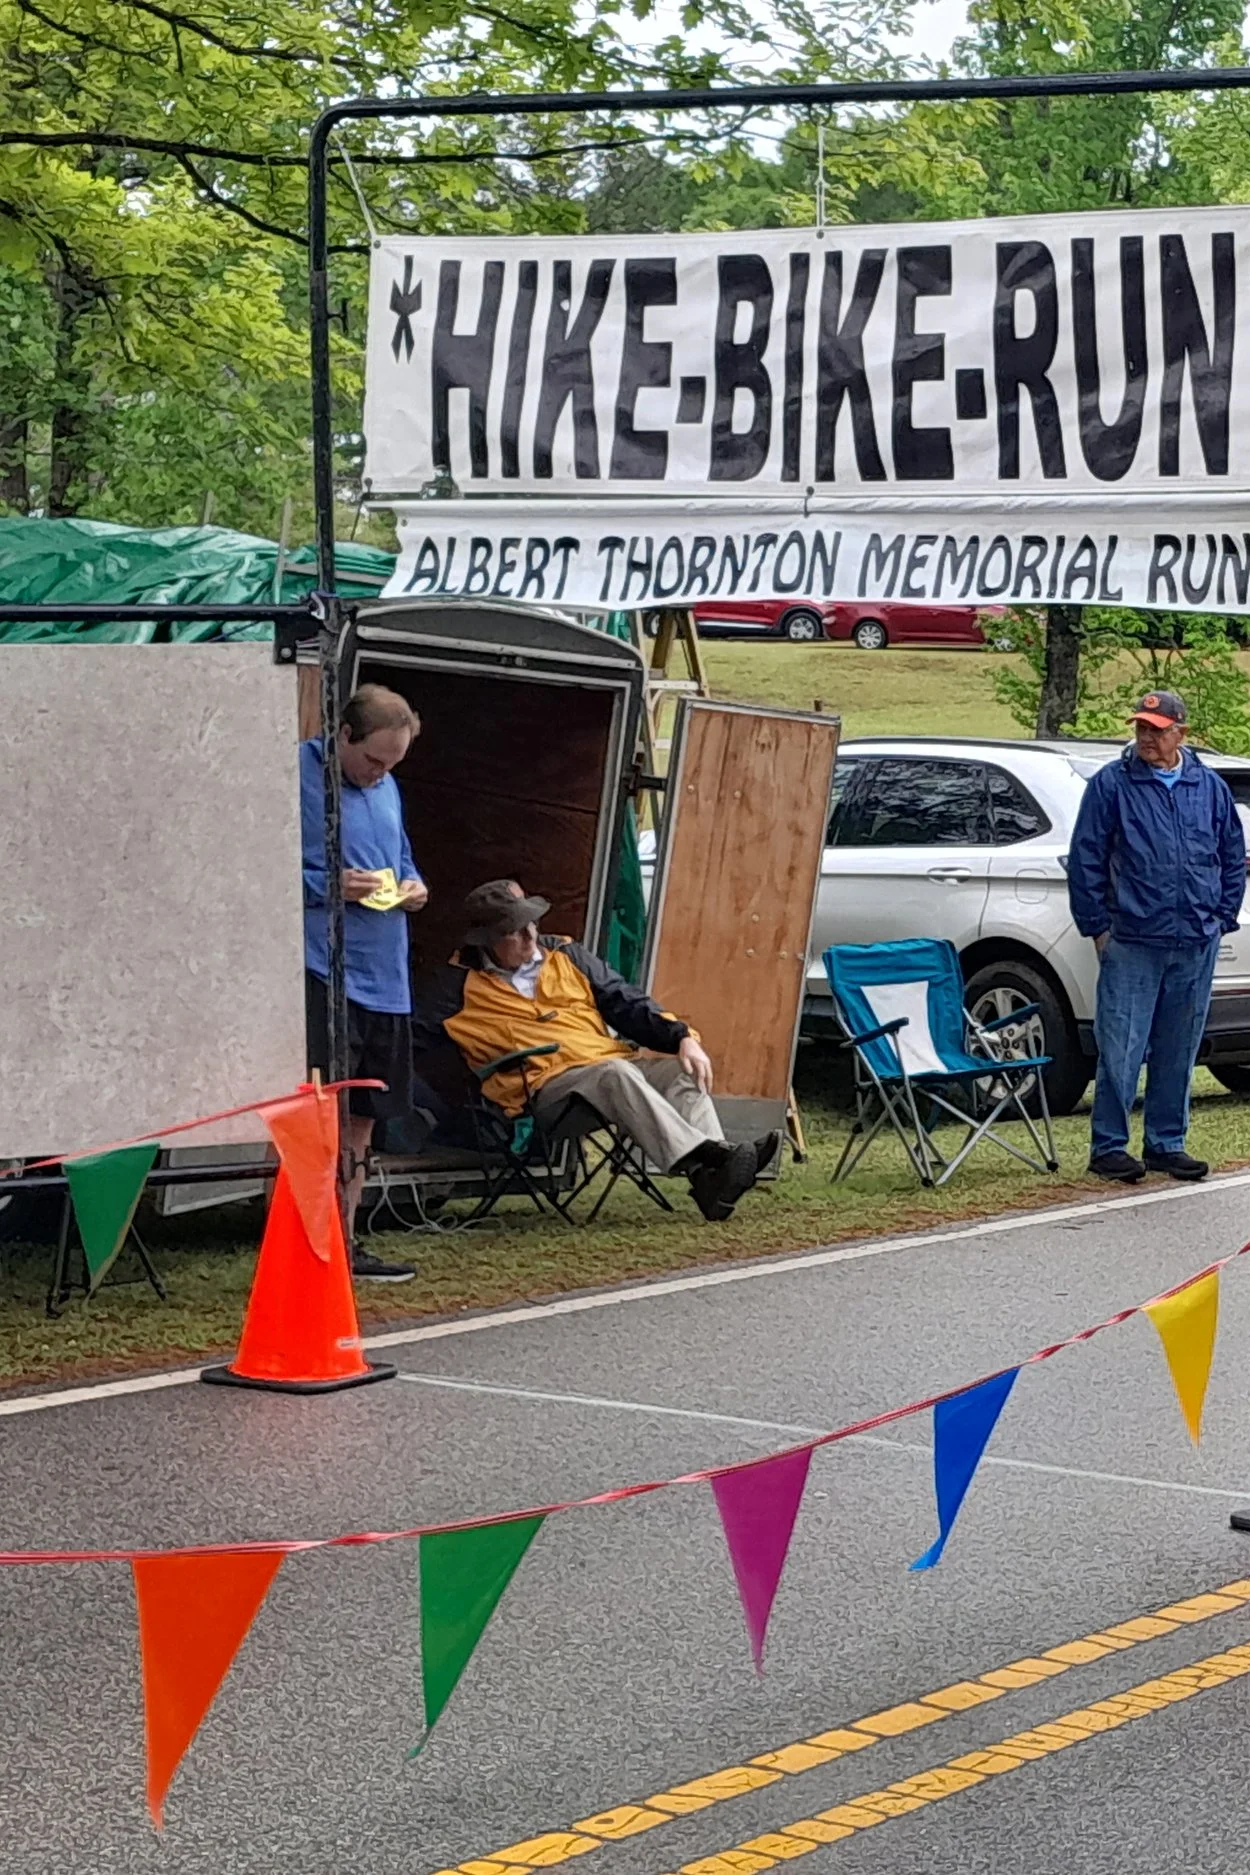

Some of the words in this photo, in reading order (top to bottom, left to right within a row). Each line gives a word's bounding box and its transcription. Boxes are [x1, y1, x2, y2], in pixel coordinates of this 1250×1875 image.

[431, 232, 1235, 482] HIKE-BIKE-RUN
[403, 536, 579, 600] ALBERT
[598, 530, 842, 602] THORNTON
[857, 533, 1123, 602] MEMORIAL
